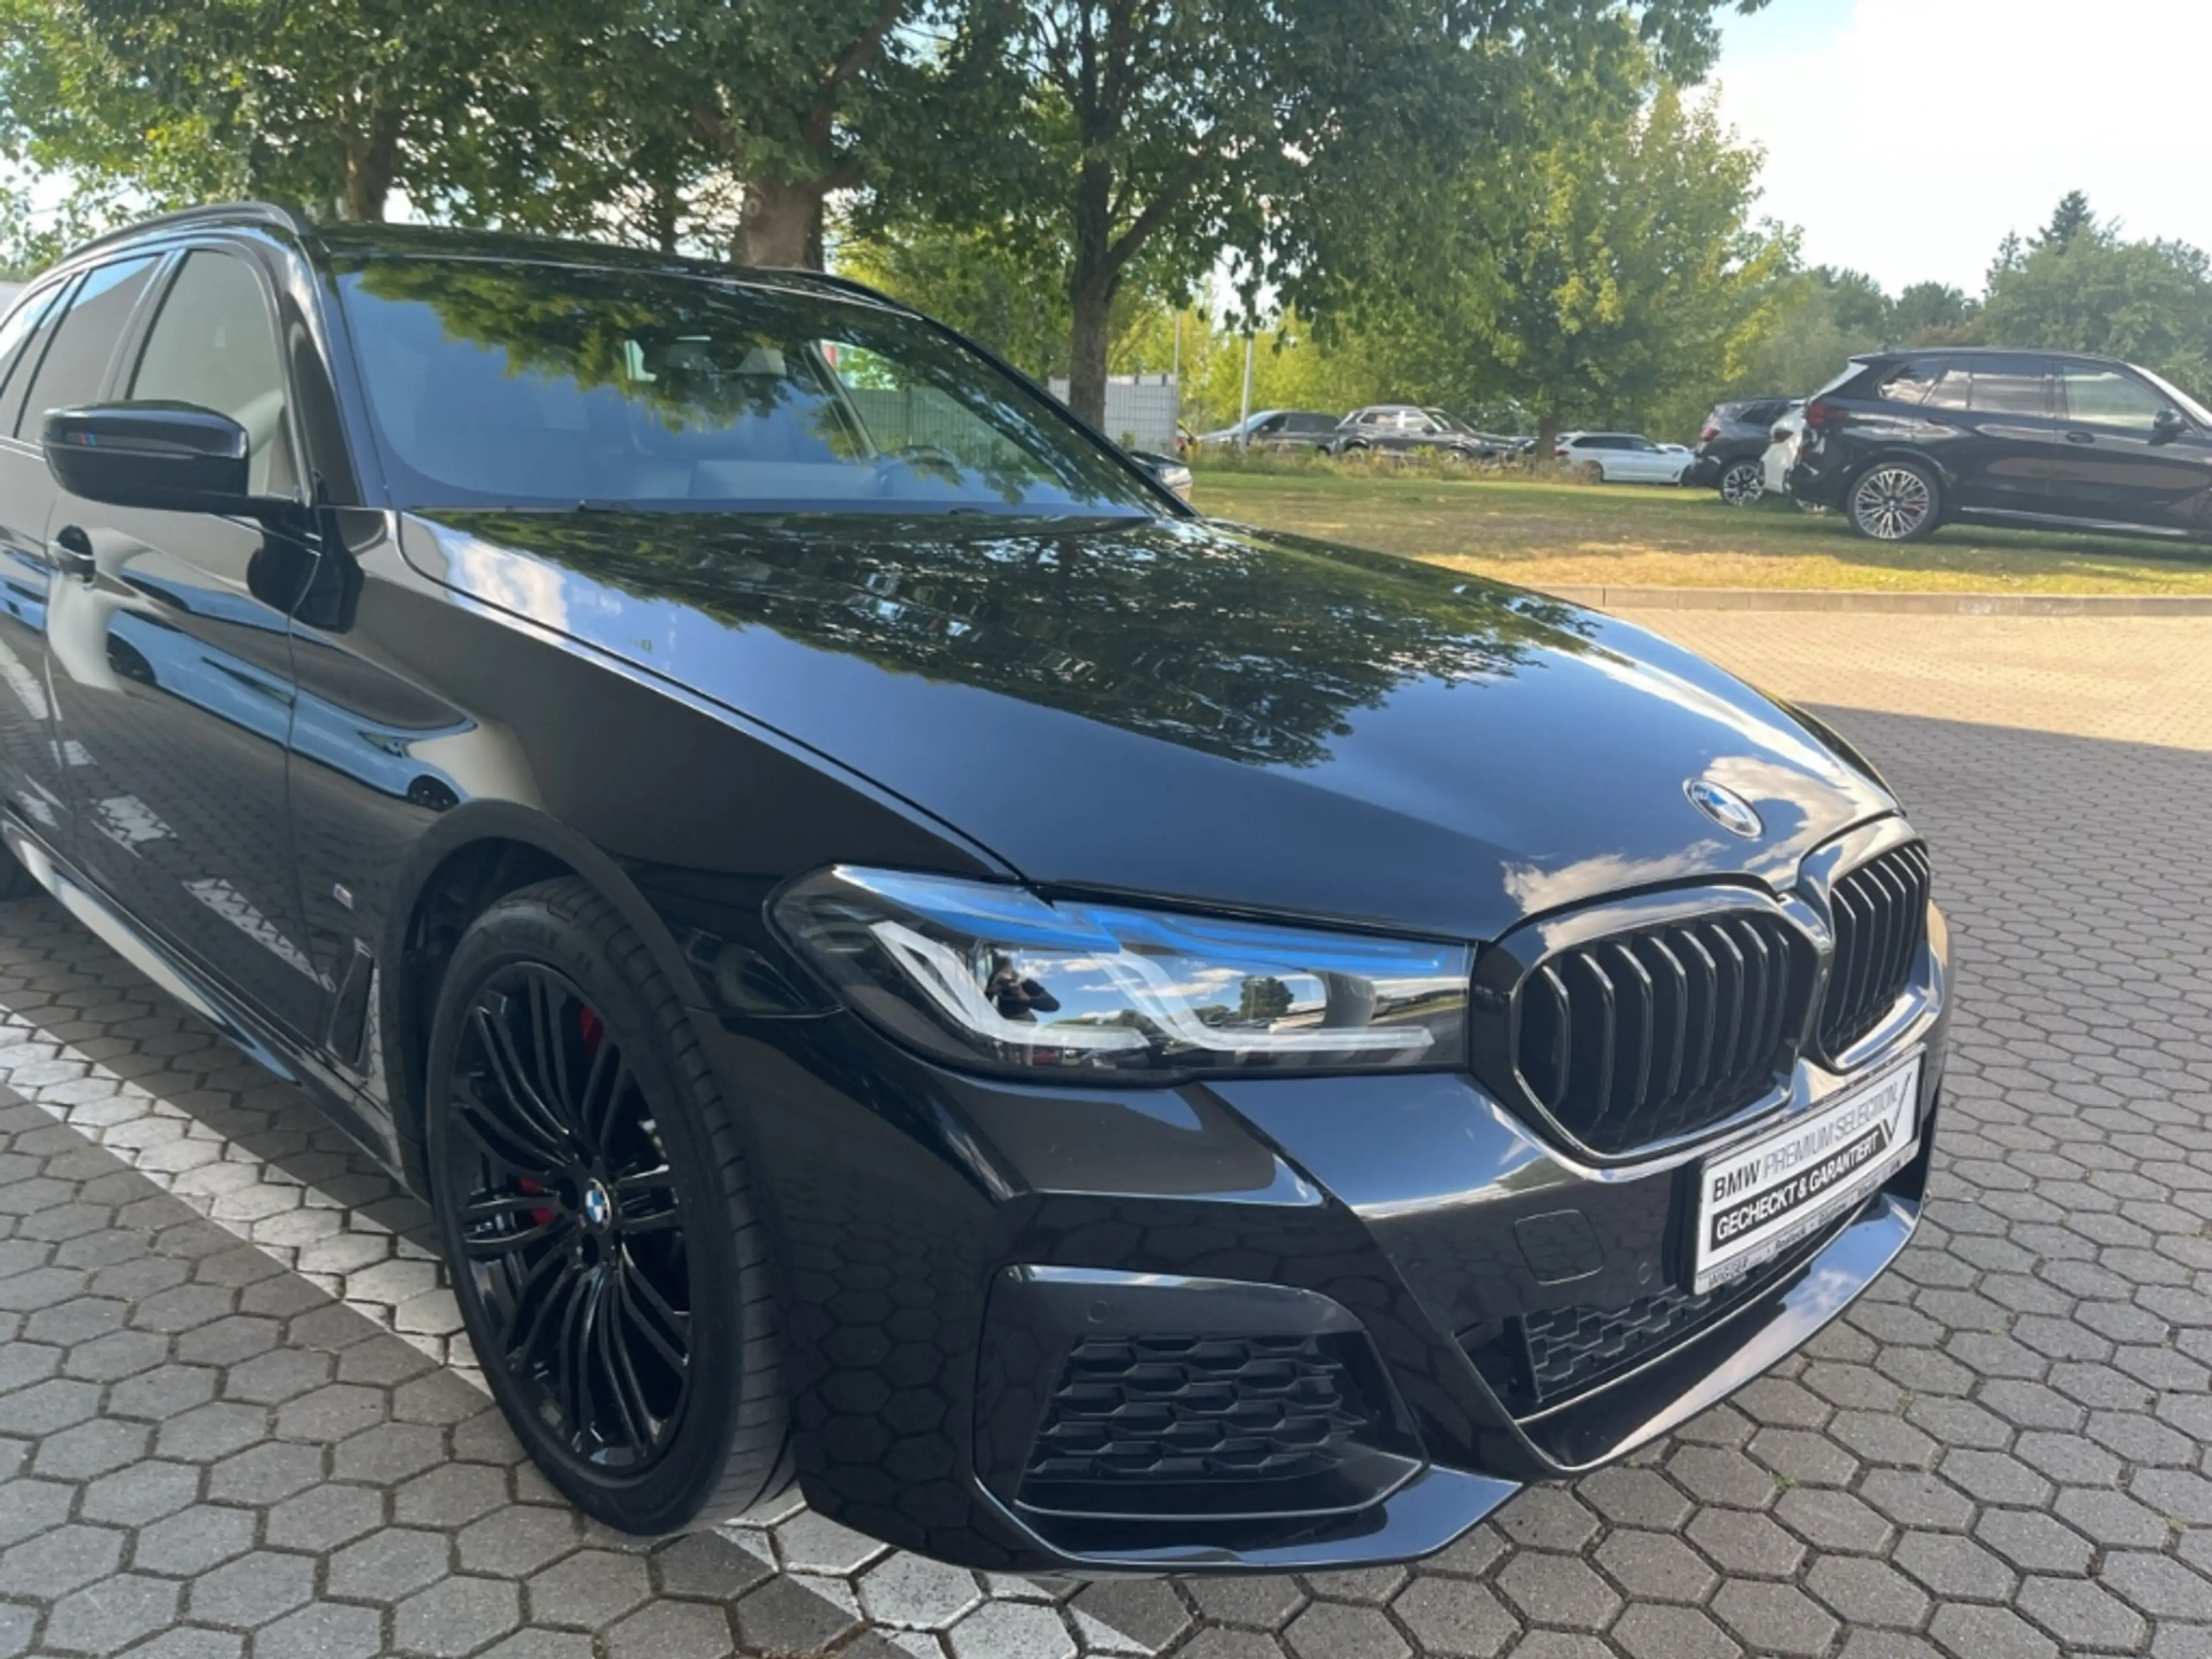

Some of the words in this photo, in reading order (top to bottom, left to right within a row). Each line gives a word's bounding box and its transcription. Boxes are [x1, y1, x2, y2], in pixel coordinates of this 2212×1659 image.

[1713, 1159, 1761, 1203] BMW
[1763, 1122, 1834, 1179] PREMIUM
[1835, 1081, 1897, 1141] SELECTION
[1717, 1181, 1798, 1241] GECHECKT
[1797, 1177, 1808, 1199] &
[1809, 1130, 1880, 1192] GARANTIERT
